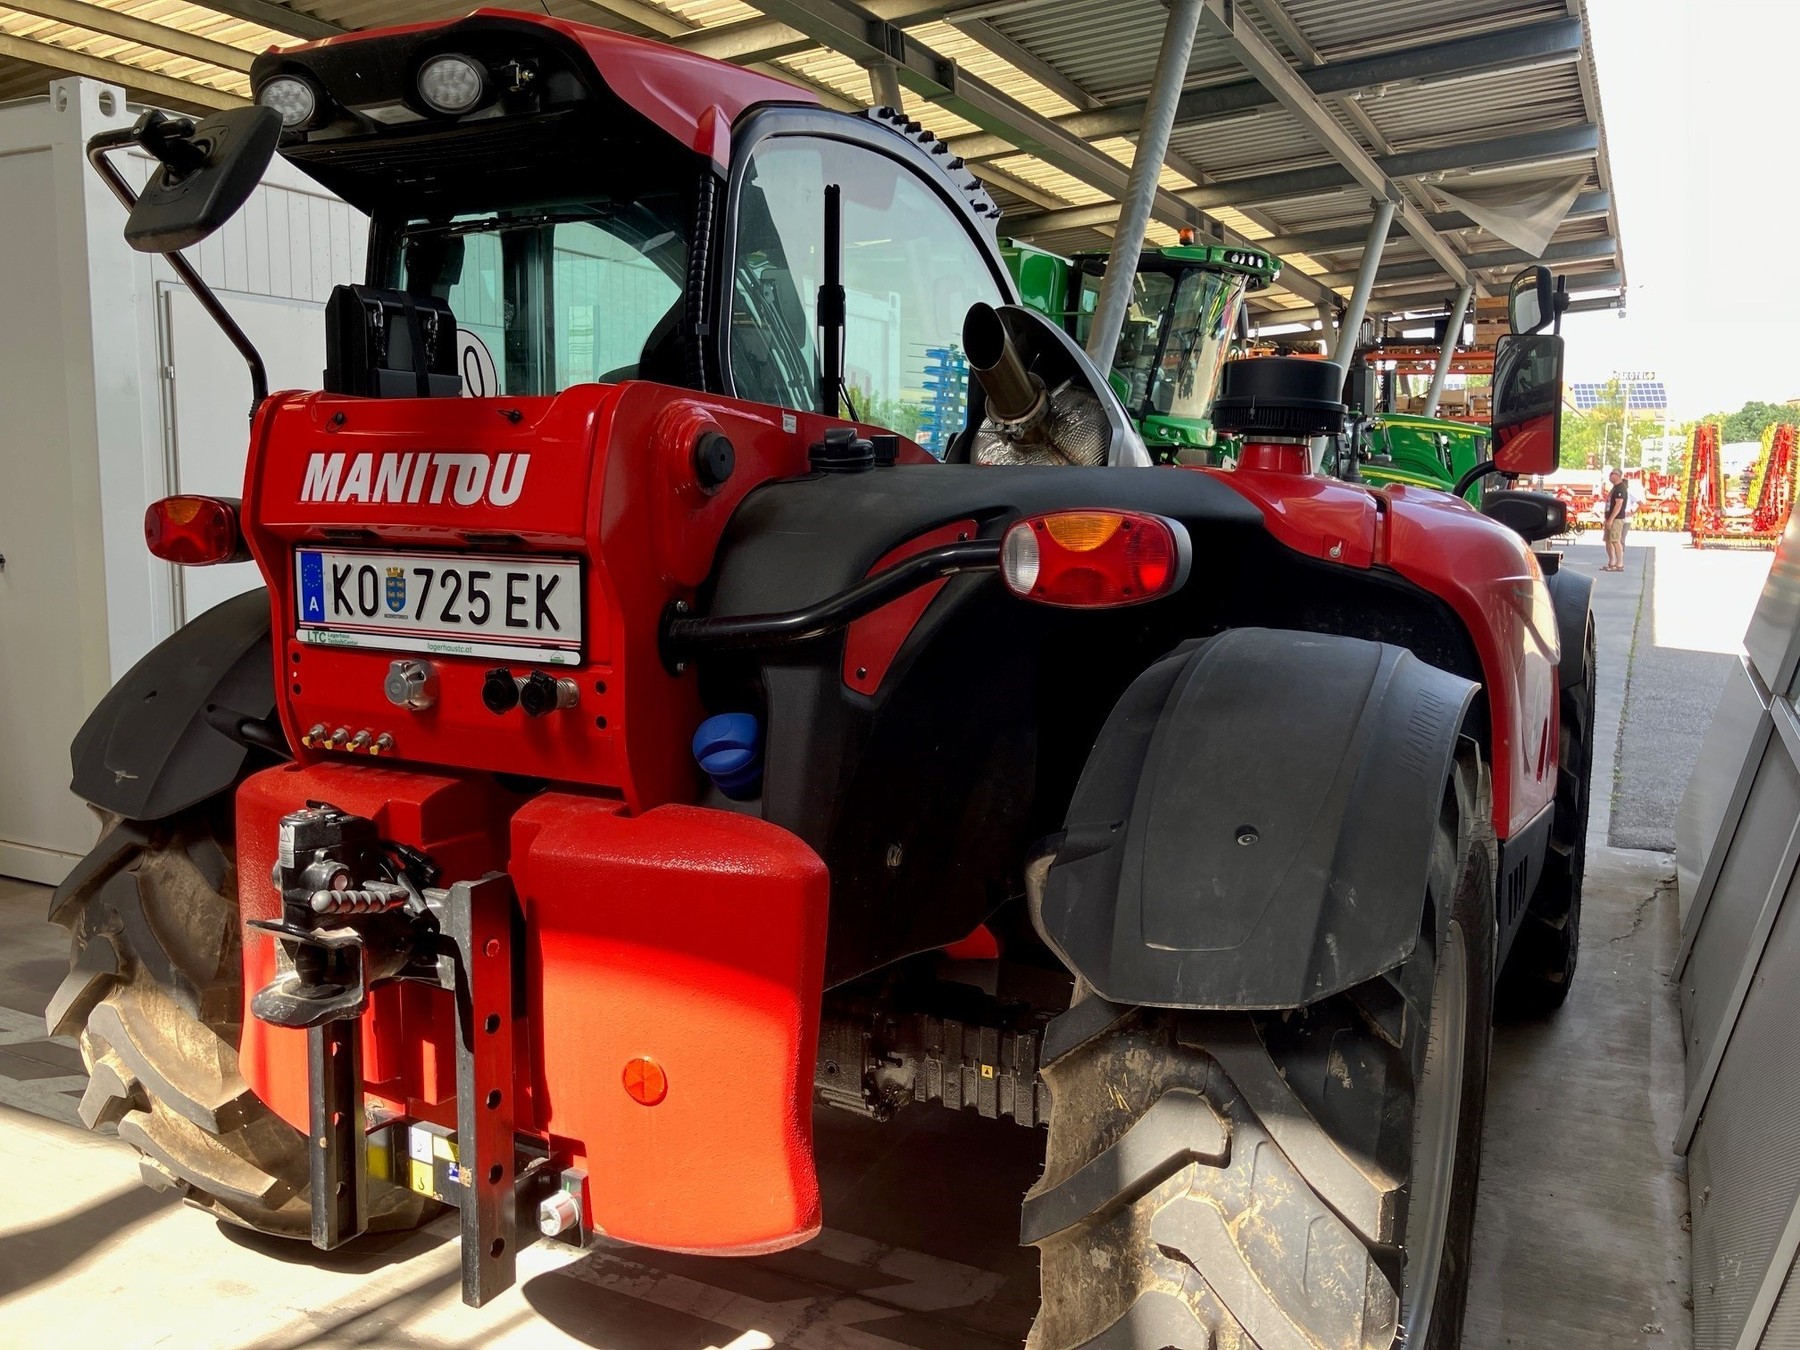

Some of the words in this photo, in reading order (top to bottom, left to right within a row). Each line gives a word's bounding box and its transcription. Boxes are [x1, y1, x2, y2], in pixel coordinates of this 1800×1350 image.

[300, 453, 531, 506] MANITOU
[309, 596, 319, 612] A
[332, 563, 379, 617] KO
[413, 568, 491, 626] 725
[505, 572, 560, 632] EK
[307, 631, 327, 643] LTC
[427, 642, 472, 654] lagerhaustc.at
